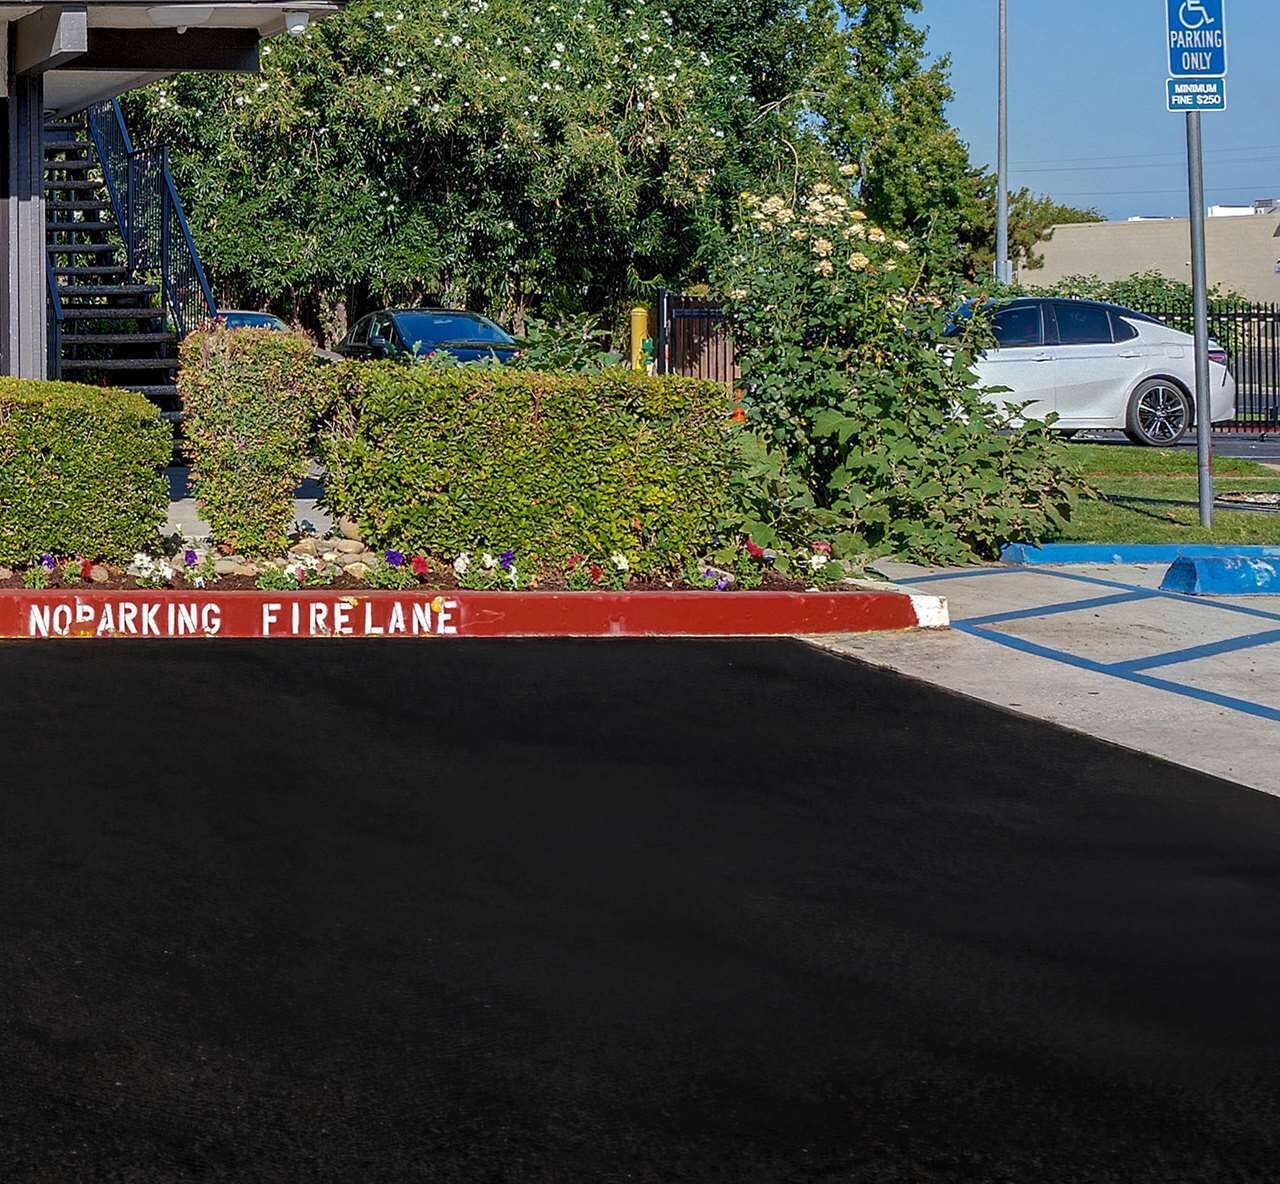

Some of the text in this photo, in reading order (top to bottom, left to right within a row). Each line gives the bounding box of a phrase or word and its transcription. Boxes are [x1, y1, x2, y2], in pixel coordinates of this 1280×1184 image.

[1170, 30, 1223, 48] PARKING
[1182, 52, 1212, 70] ONLY
[1174, 83, 1217, 93] MINIMUM
[1171, 95, 1221, 105] FINE $250
